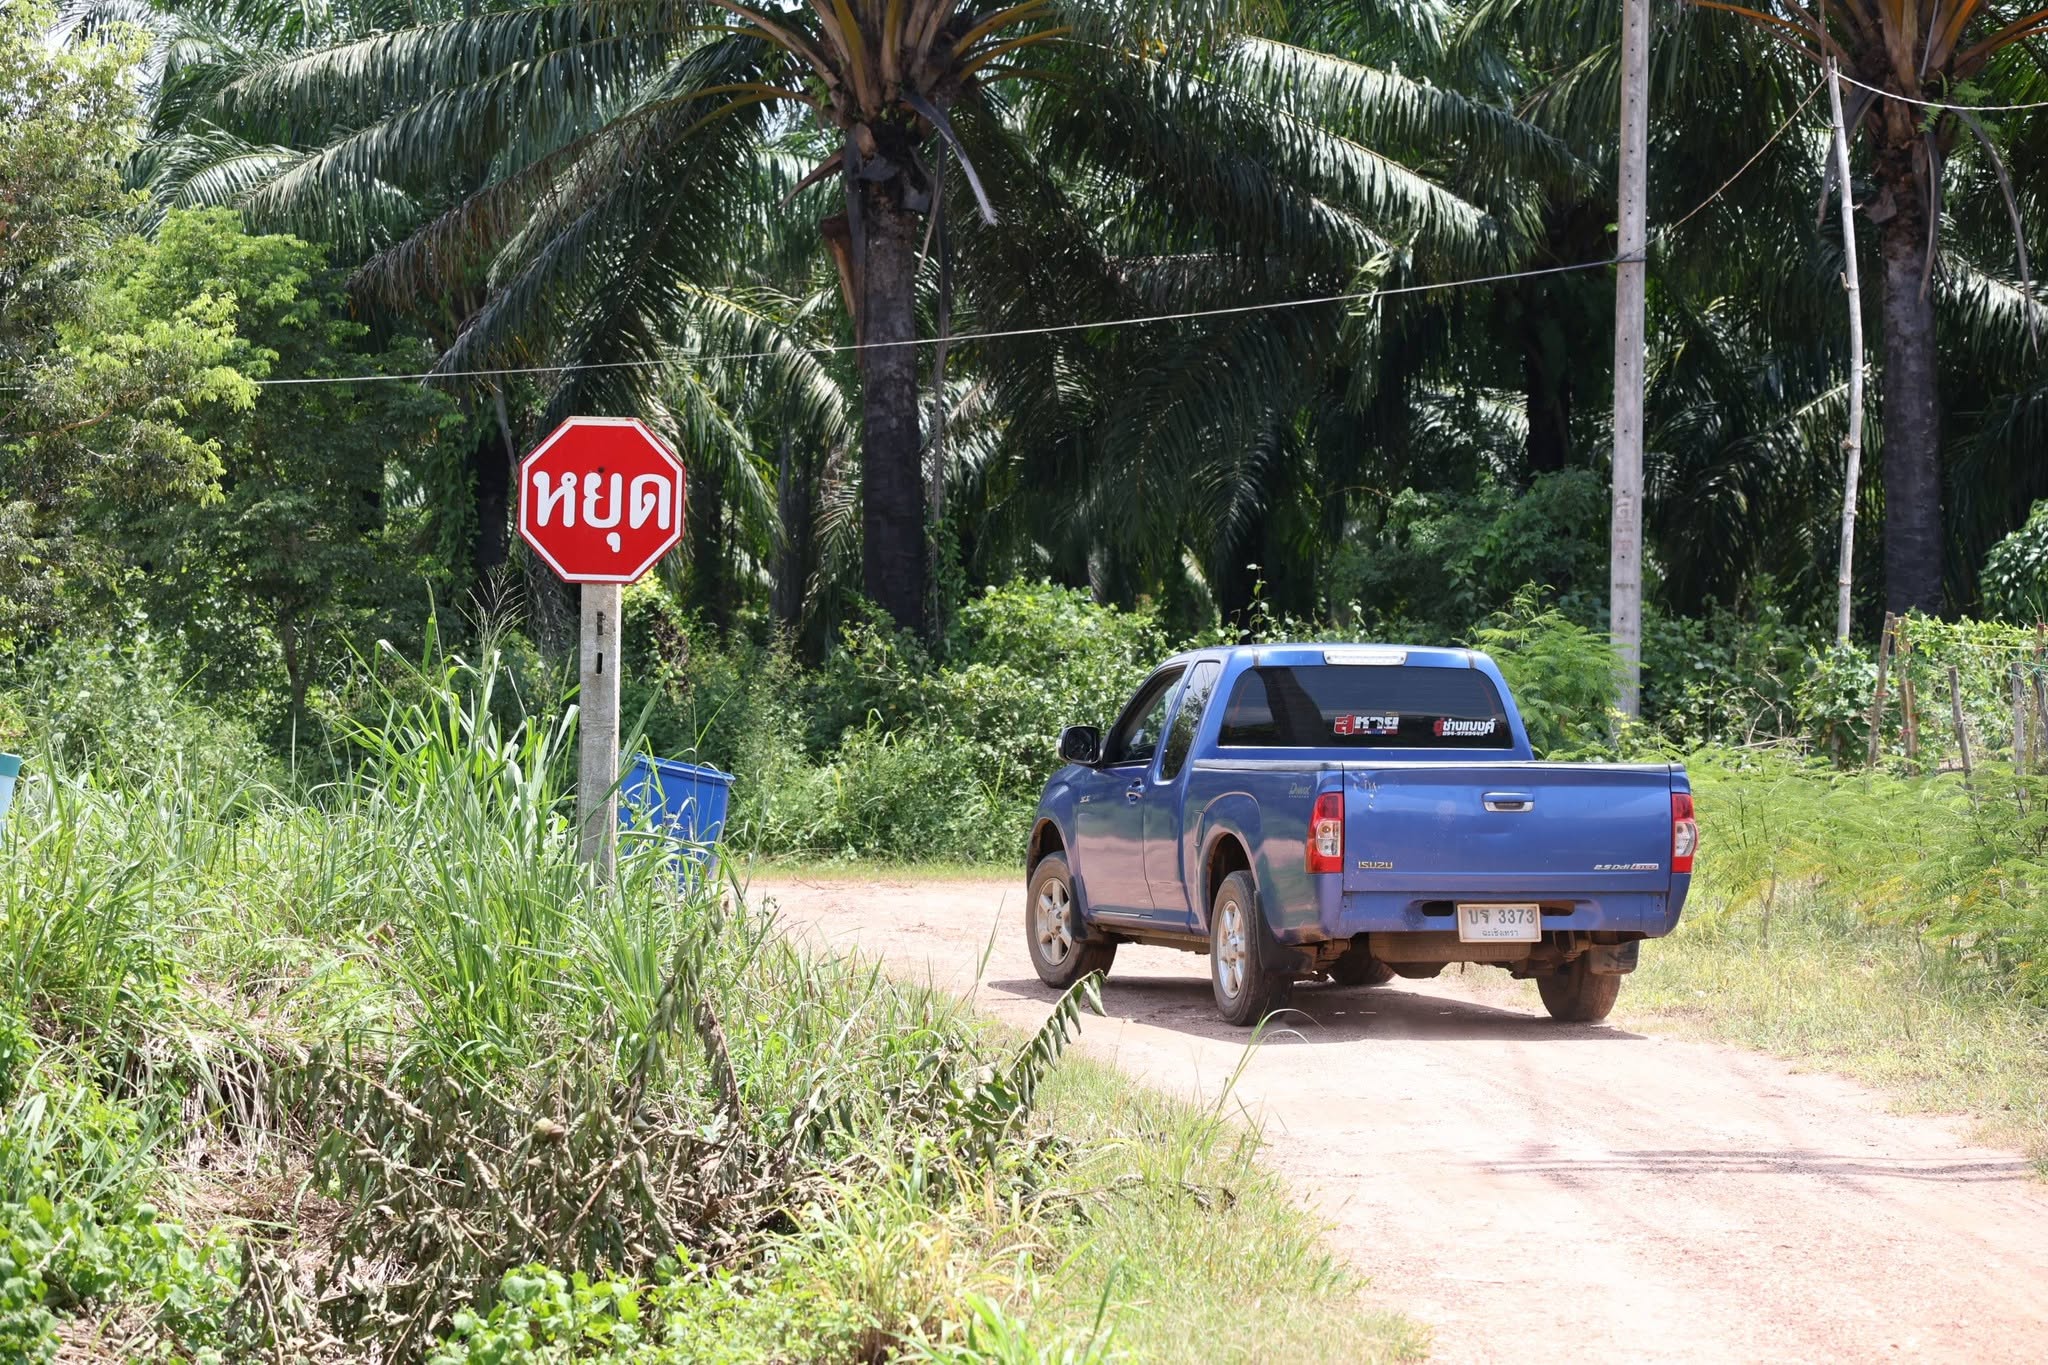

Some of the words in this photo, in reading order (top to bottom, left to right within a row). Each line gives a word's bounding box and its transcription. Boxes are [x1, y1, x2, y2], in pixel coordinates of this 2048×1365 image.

[532, 471, 671, 553] หยุด
[1358, 861, 1393, 869] ISUZU
[1498, 909, 1535, 924] 3373
